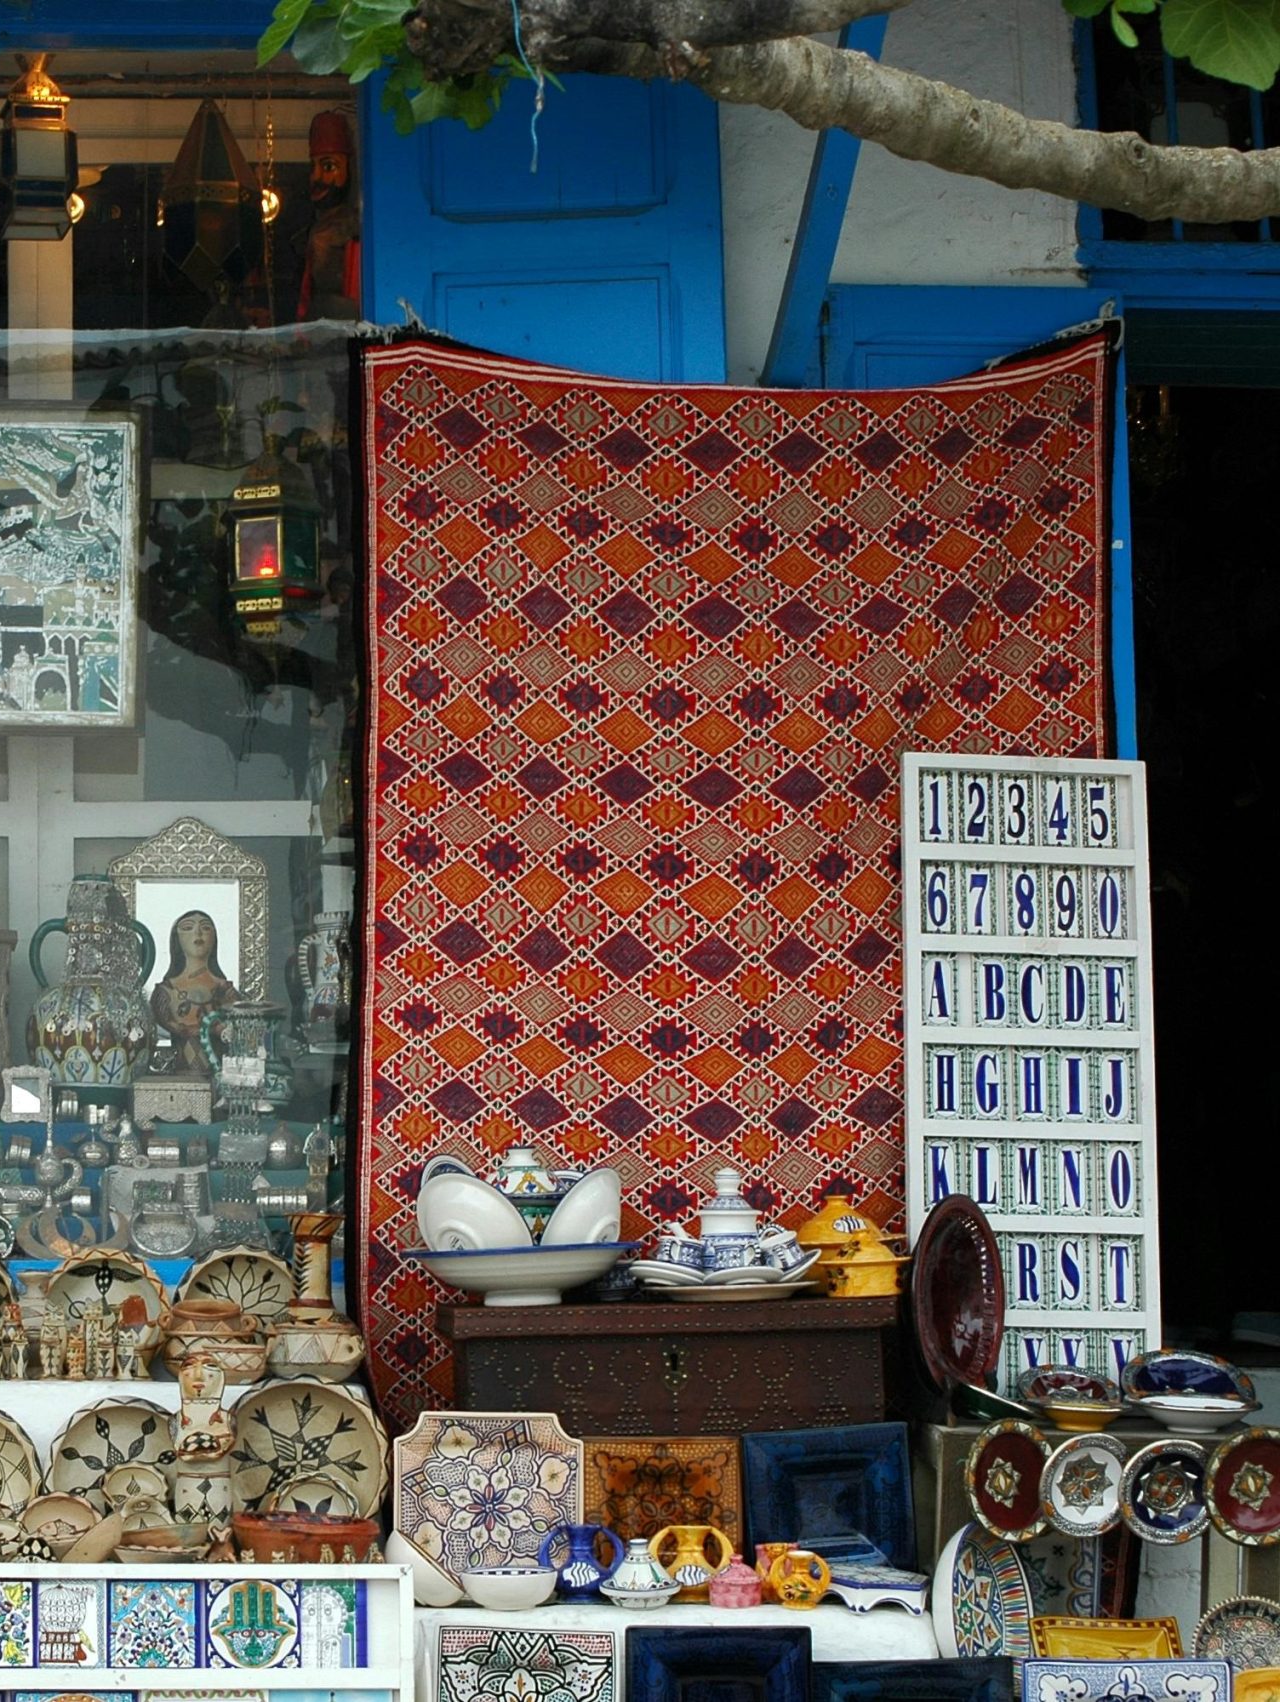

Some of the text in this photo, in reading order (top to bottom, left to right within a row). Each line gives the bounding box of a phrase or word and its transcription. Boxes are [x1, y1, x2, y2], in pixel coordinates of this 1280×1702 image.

[929, 783, 1108, 841] 1 2 3 4 5
[927, 871, 1119, 933] 6 7 8 9 0
[928, 961, 1124, 1023] A B C D E
[935, 1055, 1123, 1117] H G H I J
[931, 1146, 1131, 1209] K L M N O
[1017, 1241, 1130, 1303] R S T
